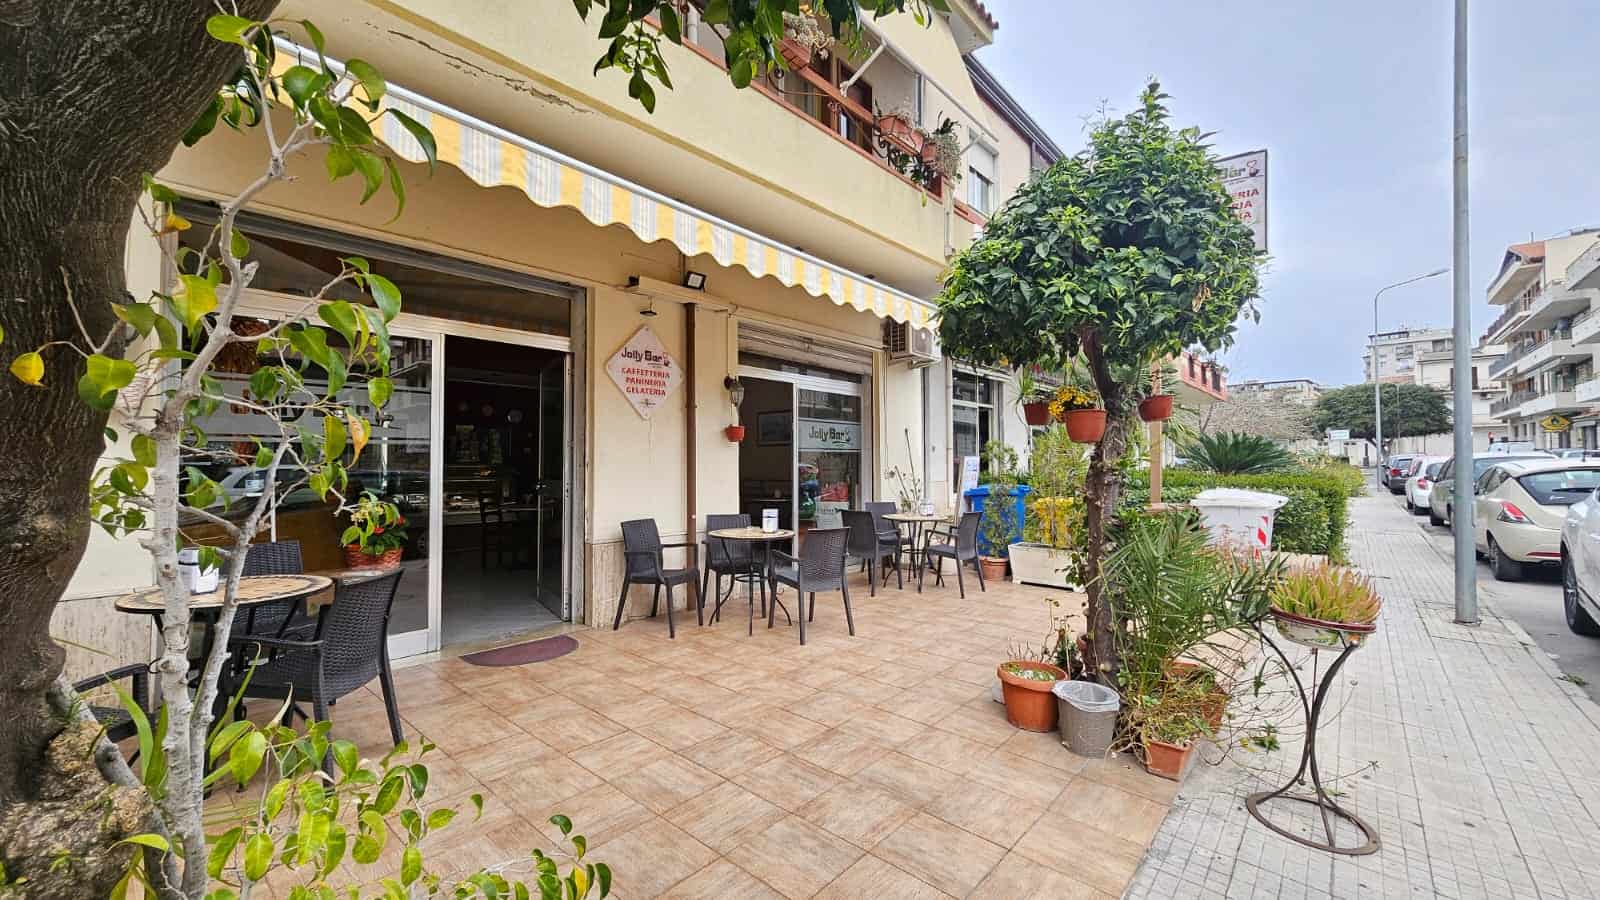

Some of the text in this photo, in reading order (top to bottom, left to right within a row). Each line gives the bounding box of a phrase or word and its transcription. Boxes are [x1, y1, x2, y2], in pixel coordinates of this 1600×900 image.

[621, 347, 663, 362] Jolly Bar
[621, 367, 671, 378] CAFFETTERIA
[625, 377, 666, 387] PANINERIA
[626, 386, 666, 396] GELATERIA
[809, 425, 845, 442] Jolly Bar
